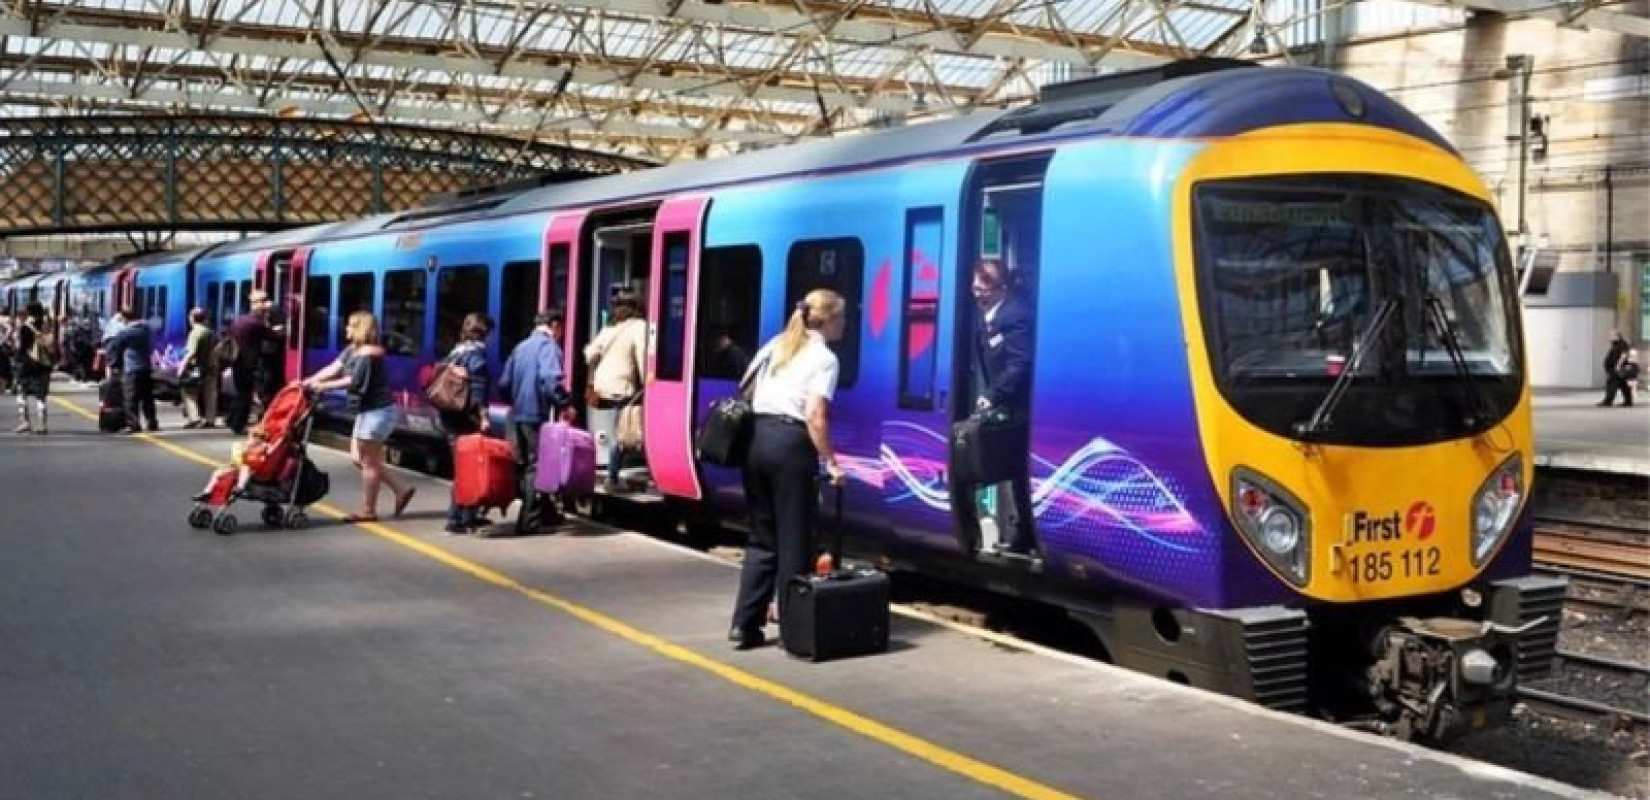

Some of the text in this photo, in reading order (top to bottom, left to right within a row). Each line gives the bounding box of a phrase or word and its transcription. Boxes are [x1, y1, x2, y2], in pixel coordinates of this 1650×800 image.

[1354, 511, 1402, 542] First
[1350, 545, 1440, 584] 185 112
